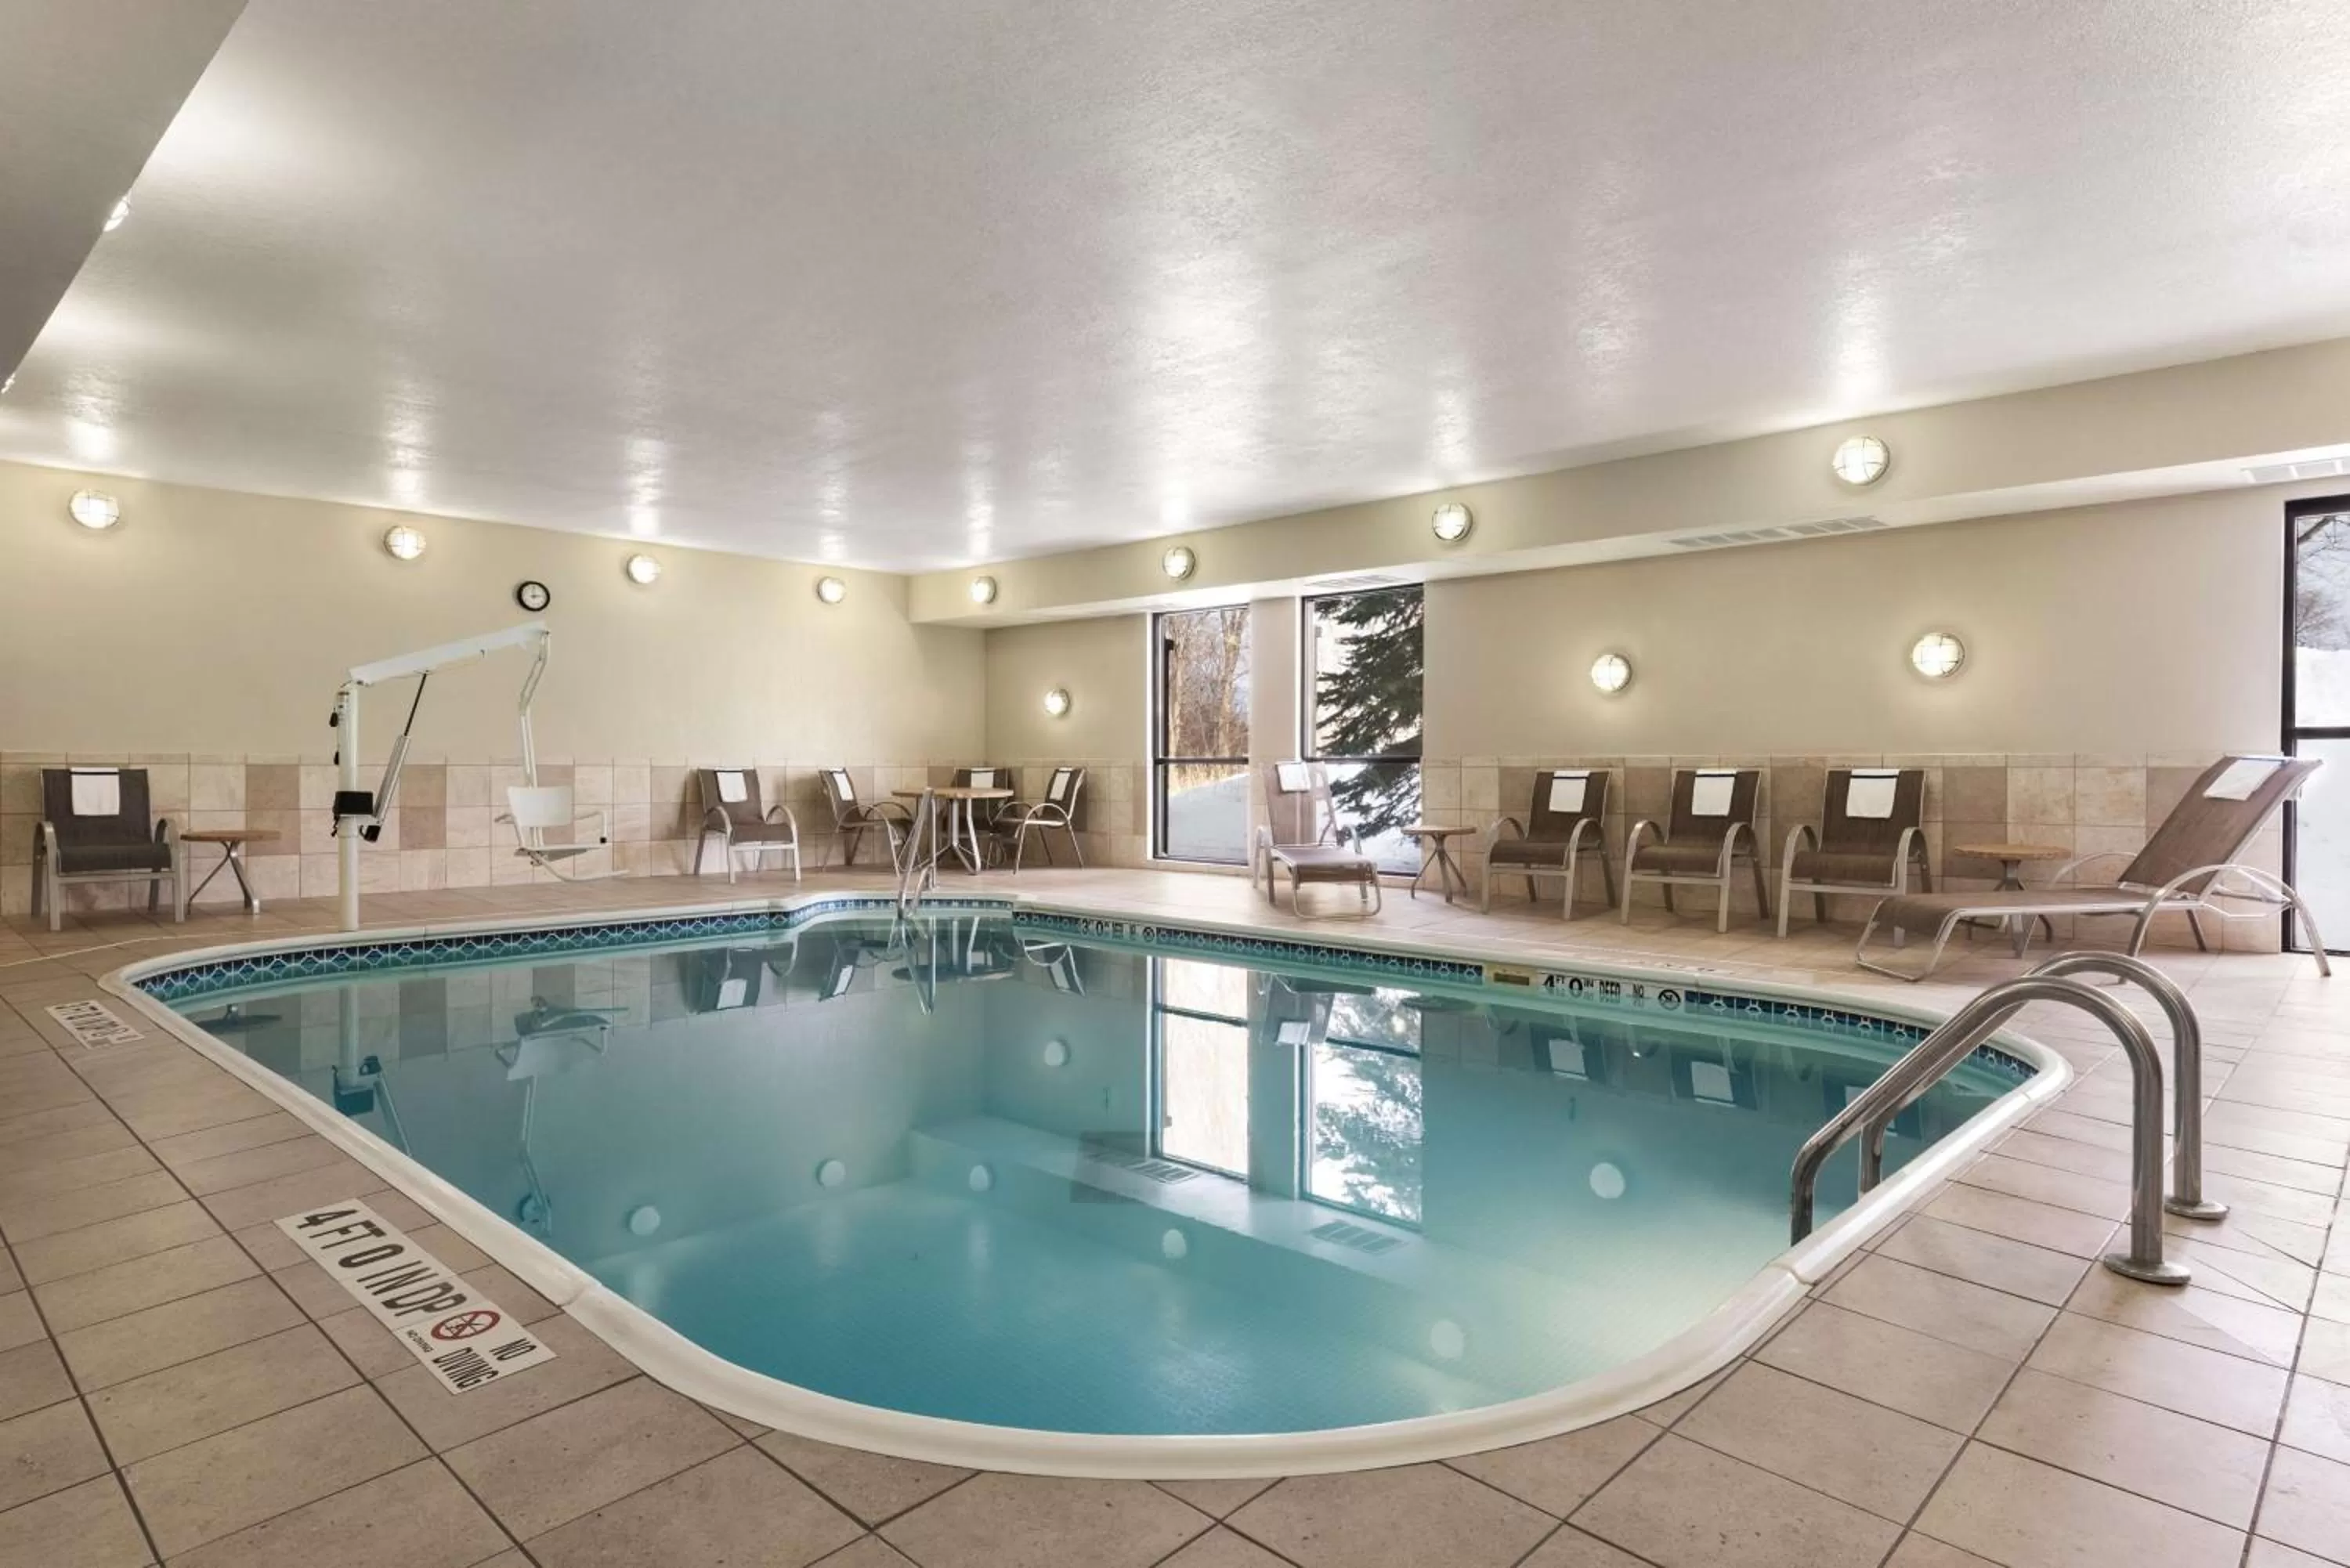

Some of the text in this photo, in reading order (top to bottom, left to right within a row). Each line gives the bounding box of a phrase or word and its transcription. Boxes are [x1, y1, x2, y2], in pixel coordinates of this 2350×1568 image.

[297, 1209, 357, 1228] 4
[309, 1220, 387, 1249] FT
[356, 1260, 439, 1296] IN
[381, 1282, 467, 1317] DP
[489, 1338, 537, 1360] NO
[432, 1347, 499, 1389] DIVING
